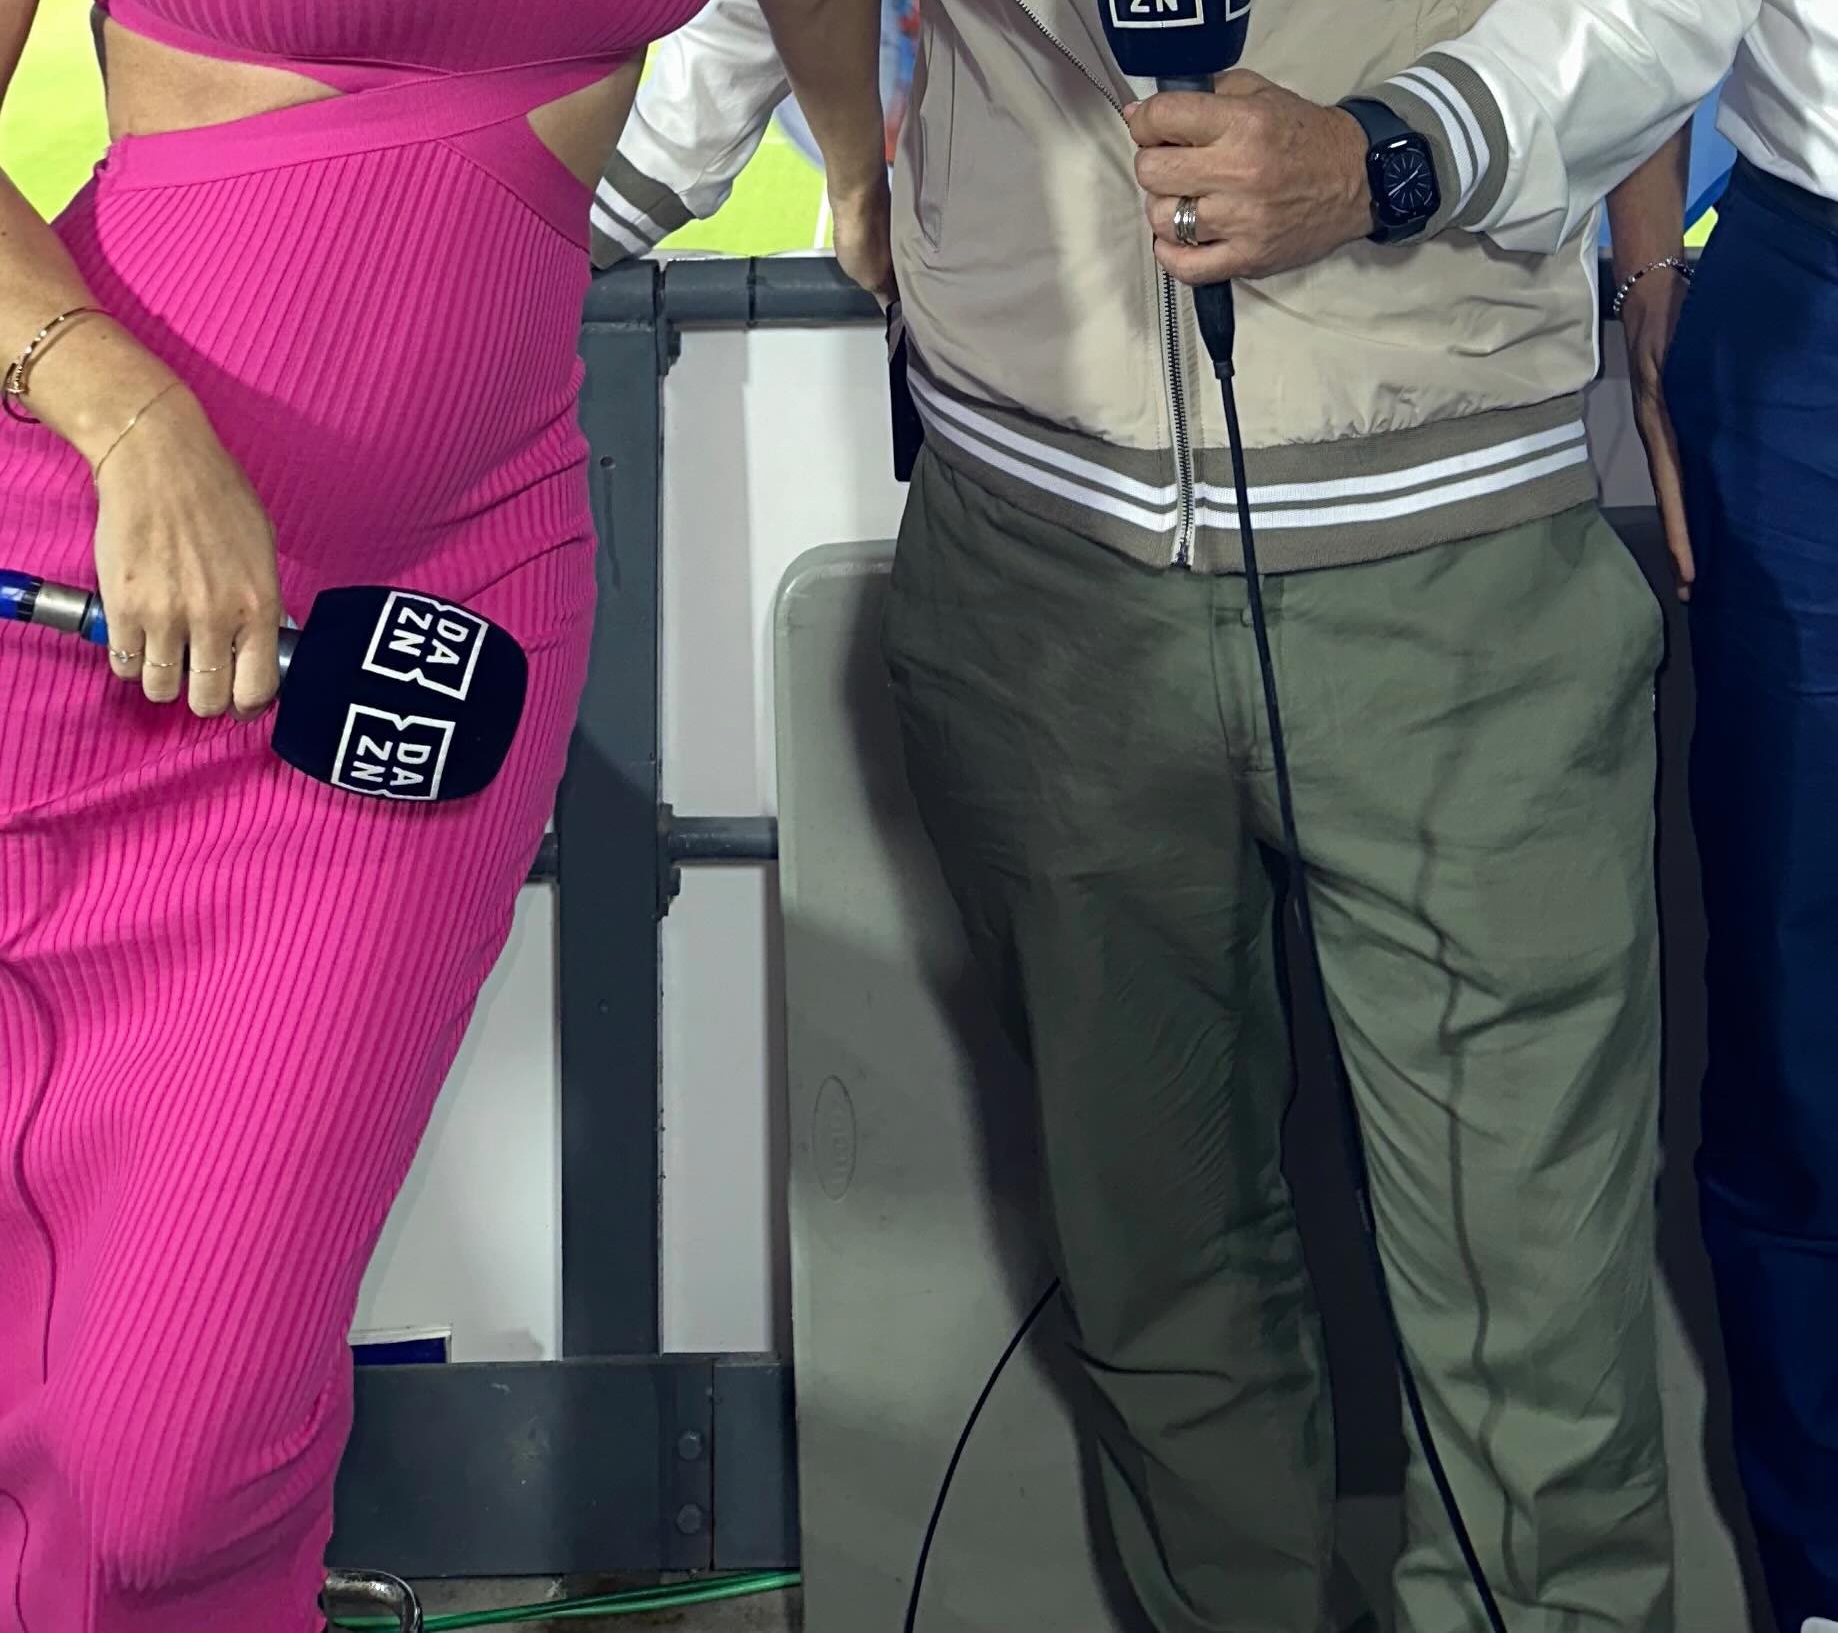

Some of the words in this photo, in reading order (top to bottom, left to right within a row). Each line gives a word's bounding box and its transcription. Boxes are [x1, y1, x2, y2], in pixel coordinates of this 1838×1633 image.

[388, 606, 433, 656] ZN
[425, 618, 469, 665] DA
[350, 735, 393, 783] ZN
[390, 742, 432, 786] DA
